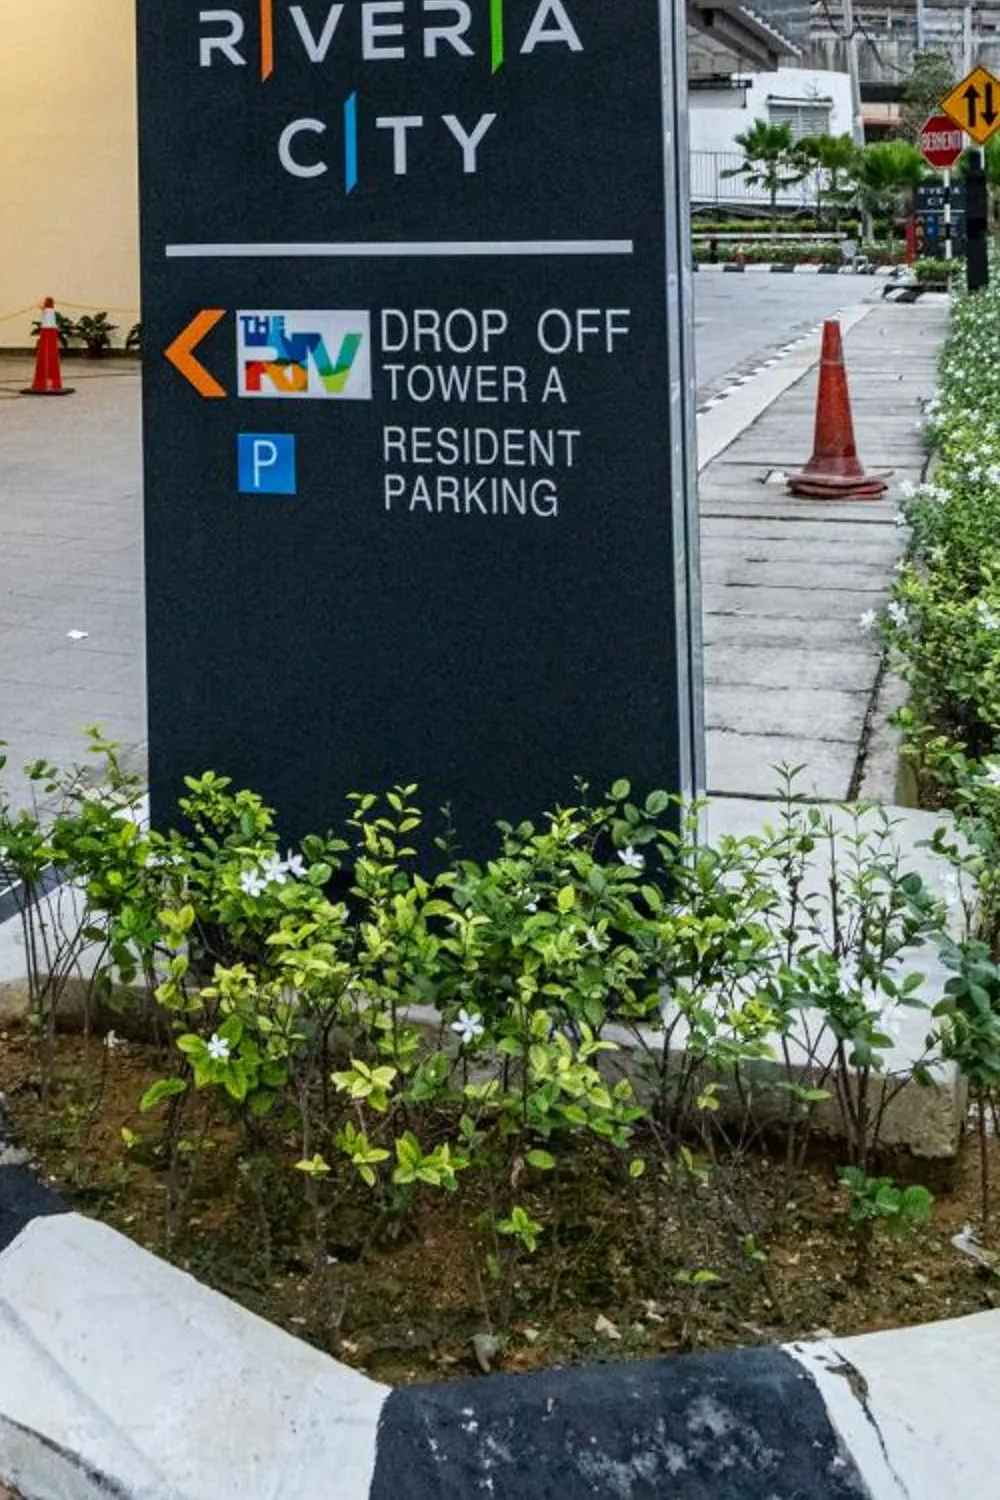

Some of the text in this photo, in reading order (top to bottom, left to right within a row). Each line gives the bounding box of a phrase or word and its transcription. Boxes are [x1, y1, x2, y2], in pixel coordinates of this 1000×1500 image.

[277, 91, 497, 196] CITY
[381, 308, 631, 353] DROP OFF
[382, 364, 567, 403] TOWER A
[253, 439, 278, 488] P
[383, 426, 581, 467] RESIDENT
[384, 474, 558, 517] PARKING
